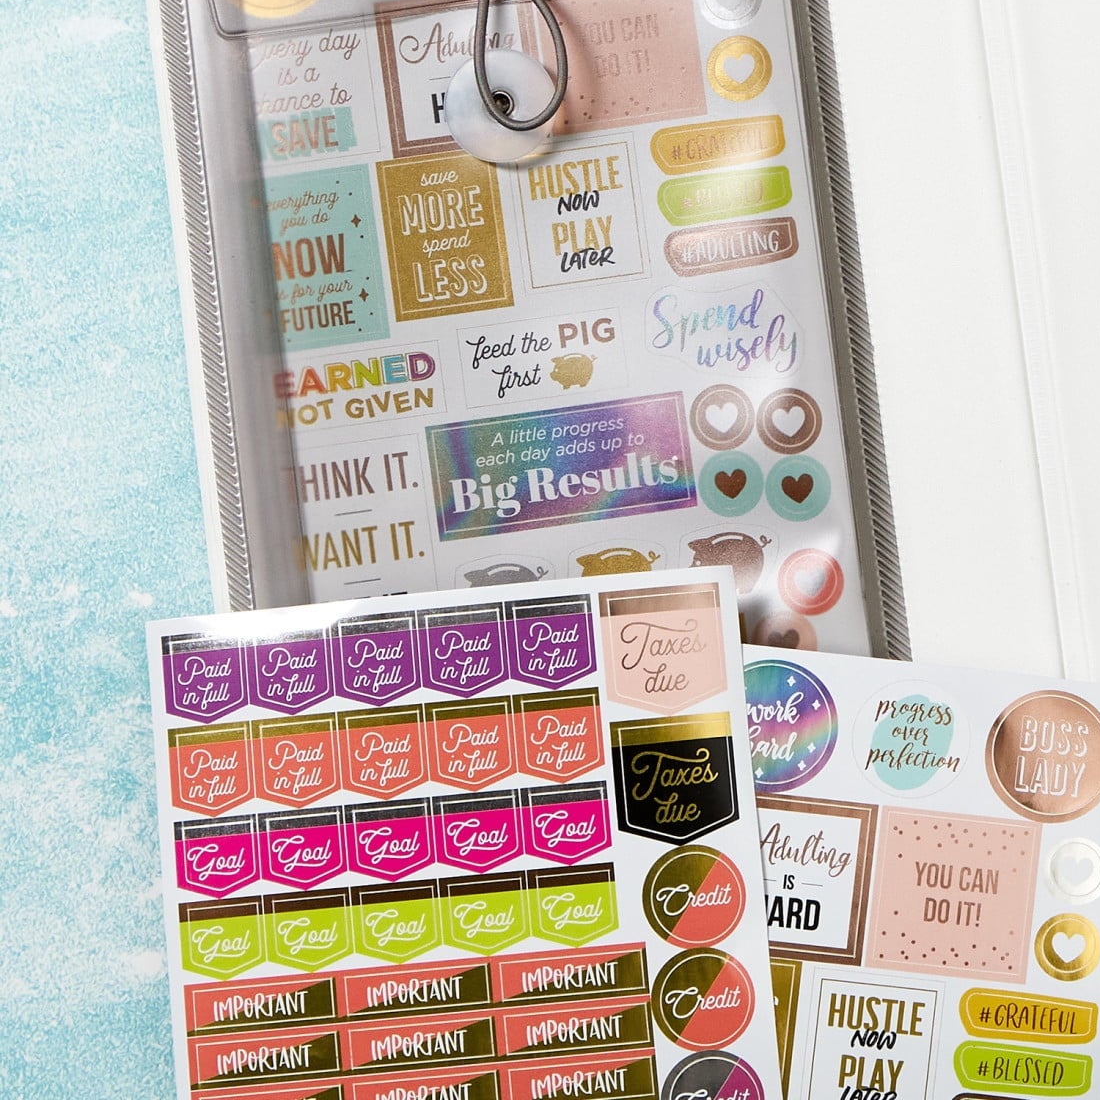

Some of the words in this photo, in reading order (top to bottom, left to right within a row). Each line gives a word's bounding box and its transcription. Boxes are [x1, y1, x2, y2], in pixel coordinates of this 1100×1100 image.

[319, 28, 361, 60] day
[330, 83, 352, 105] to
[271, 115, 339, 155] SAVE
[420, 169, 459, 187] save
[528, 155, 624, 201] HUSTLE
[312, 209, 331, 225] do
[398, 185, 484, 236] MORE
[557, 190, 600, 216] NOW
[422, 230, 471, 258] spend
[551, 215, 612, 256] PLAY
[682, 229, 780, 263] #ADULTING
[271, 233, 345, 281] NOW
[318, 279, 353, 302] your
[413, 254, 488, 303] LESS
[280, 300, 356, 333] FUTURE
[652, 288, 764, 353] Spend
[466, 335, 516, 370] feed
[520, 331, 552, 354] the
[558, 317, 616, 349] PIG
[697, 314, 798, 373] wisely
[273, 351, 436, 399] EARNED
[492, 363, 541, 399] first
[276, 398, 334, 430] NOT
[345, 387, 434, 420] GIVEN
[491, 433, 505, 447] A
[509, 426, 547, 446] little
[551, 417, 625, 442] progress
[475, 451, 516, 468] each
[520, 445, 551, 466] day
[555, 438, 596, 458] adds
[601, 436, 623, 453] up
[627, 432, 645, 446] to
[383, 451, 419, 491] IT.
[449, 476, 522, 519] Big
[525, 452, 680, 503] Results
[389, 520, 425, 561] IT.
[348, 638, 404, 668] Paid
[435, 630, 492, 660] Paid
[620, 618, 706, 670] Taxes
[178, 656, 232, 685] Paid
[262, 648, 317, 677] Paid
[353, 673, 370, 688] in
[368, 665, 403, 693] full
[440, 665, 457, 680] in
[455, 656, 490, 684] full
[643, 663, 690, 694] due
[182, 689, 199, 705] in
[197, 683, 230, 710] full
[267, 681, 283, 697] in
[281, 674, 315, 701] full
[746, 692, 803, 727] work
[874, 698, 953, 727] progress
[891, 723, 930, 744] over
[1018, 714, 1091, 758] BOSS
[631, 748, 718, 801] Taxes
[864, 746, 961, 773] perfection
[1013, 754, 1087, 799] LADY
[654, 792, 701, 824] due
[358, 827, 421, 864] Goal
[447, 818, 509, 856] Goal
[534, 810, 596, 848] Goal
[187, 843, 245, 881] Goal
[272, 835, 332, 873] Goal
[759, 822, 853, 878] Adulting
[782, 874, 796, 891] IS
[914, 861, 957, 890] YOU
[958, 867, 1000, 896] CAN
[655, 883, 732, 917] Credit
[923, 896, 953, 925] DO
[955, 900, 982, 928] IT!
[665, 986, 741, 1020] Credit
[827, 993, 926, 1037] HUSTLE
[979, 1003, 1080, 1035] #GRATEFUL
[850, 1029, 898, 1050] NOW
[839, 1054, 904, 1094] PLAY
[977, 1056, 1065, 1086] #BLESSED
